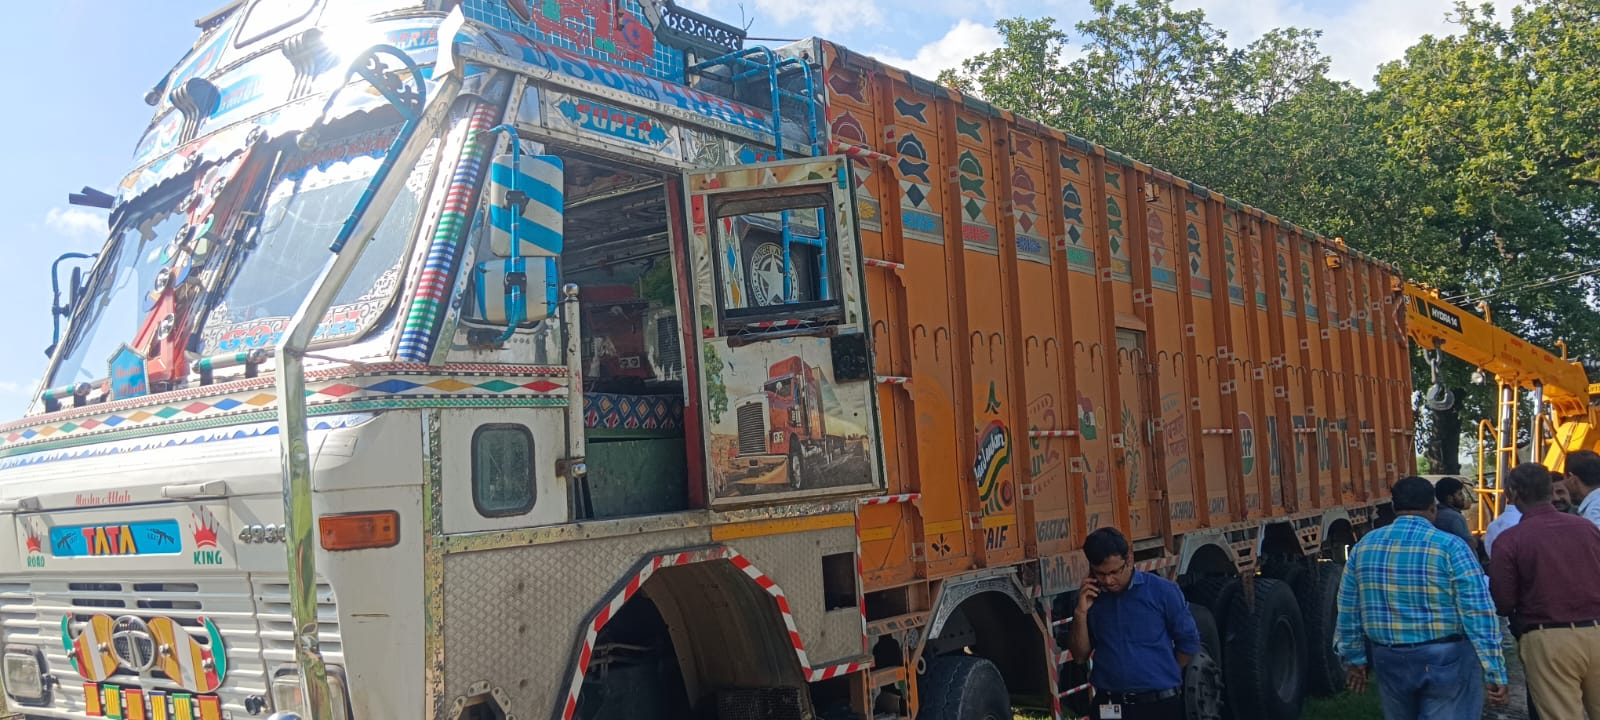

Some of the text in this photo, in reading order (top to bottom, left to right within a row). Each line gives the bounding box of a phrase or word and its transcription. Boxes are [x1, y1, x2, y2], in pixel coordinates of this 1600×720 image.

[631, 87, 657, 101] TATA
[576, 103, 652, 142] SUPER
[1431, 307, 1451, 325] HYDRA
[81, 525, 138, 555] TATA
[984, 525, 1009, 550] AIF
[1037, 518, 1069, 542] GISTICS
[27, 555, 46, 568] ROAD
[193, 550, 223, 565] KING
